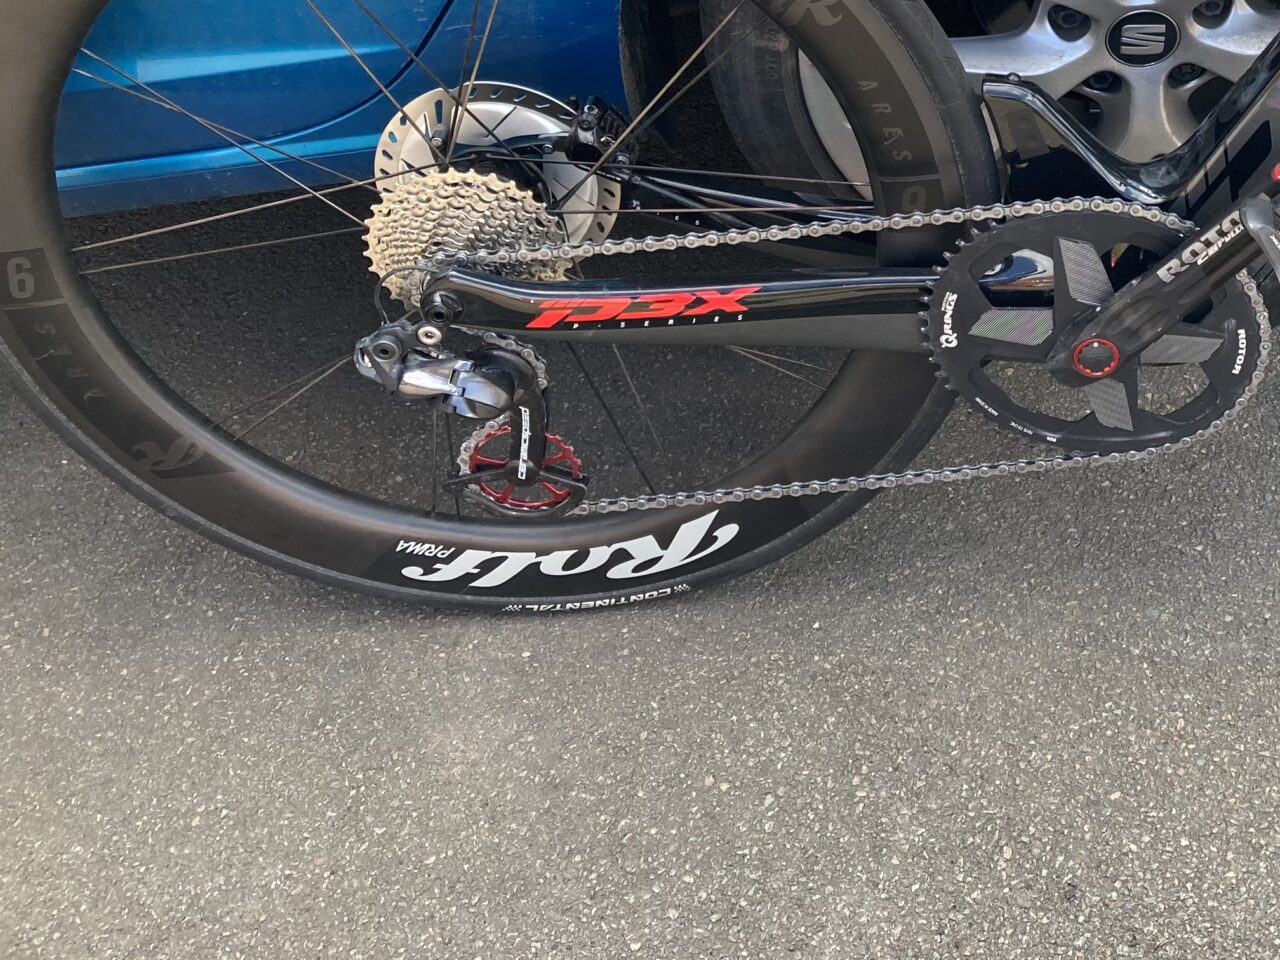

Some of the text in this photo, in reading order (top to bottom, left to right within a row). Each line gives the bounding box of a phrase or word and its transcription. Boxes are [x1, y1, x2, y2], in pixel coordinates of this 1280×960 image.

[1156, 210, 1240, 284] ROTO
[526, 286, 763, 329] P3X
[1231, 328, 1247, 375] ROTOR
[396, 509, 740, 588] Rolf PRIMA
[525, 587, 673, 612] CONTINENTAL
